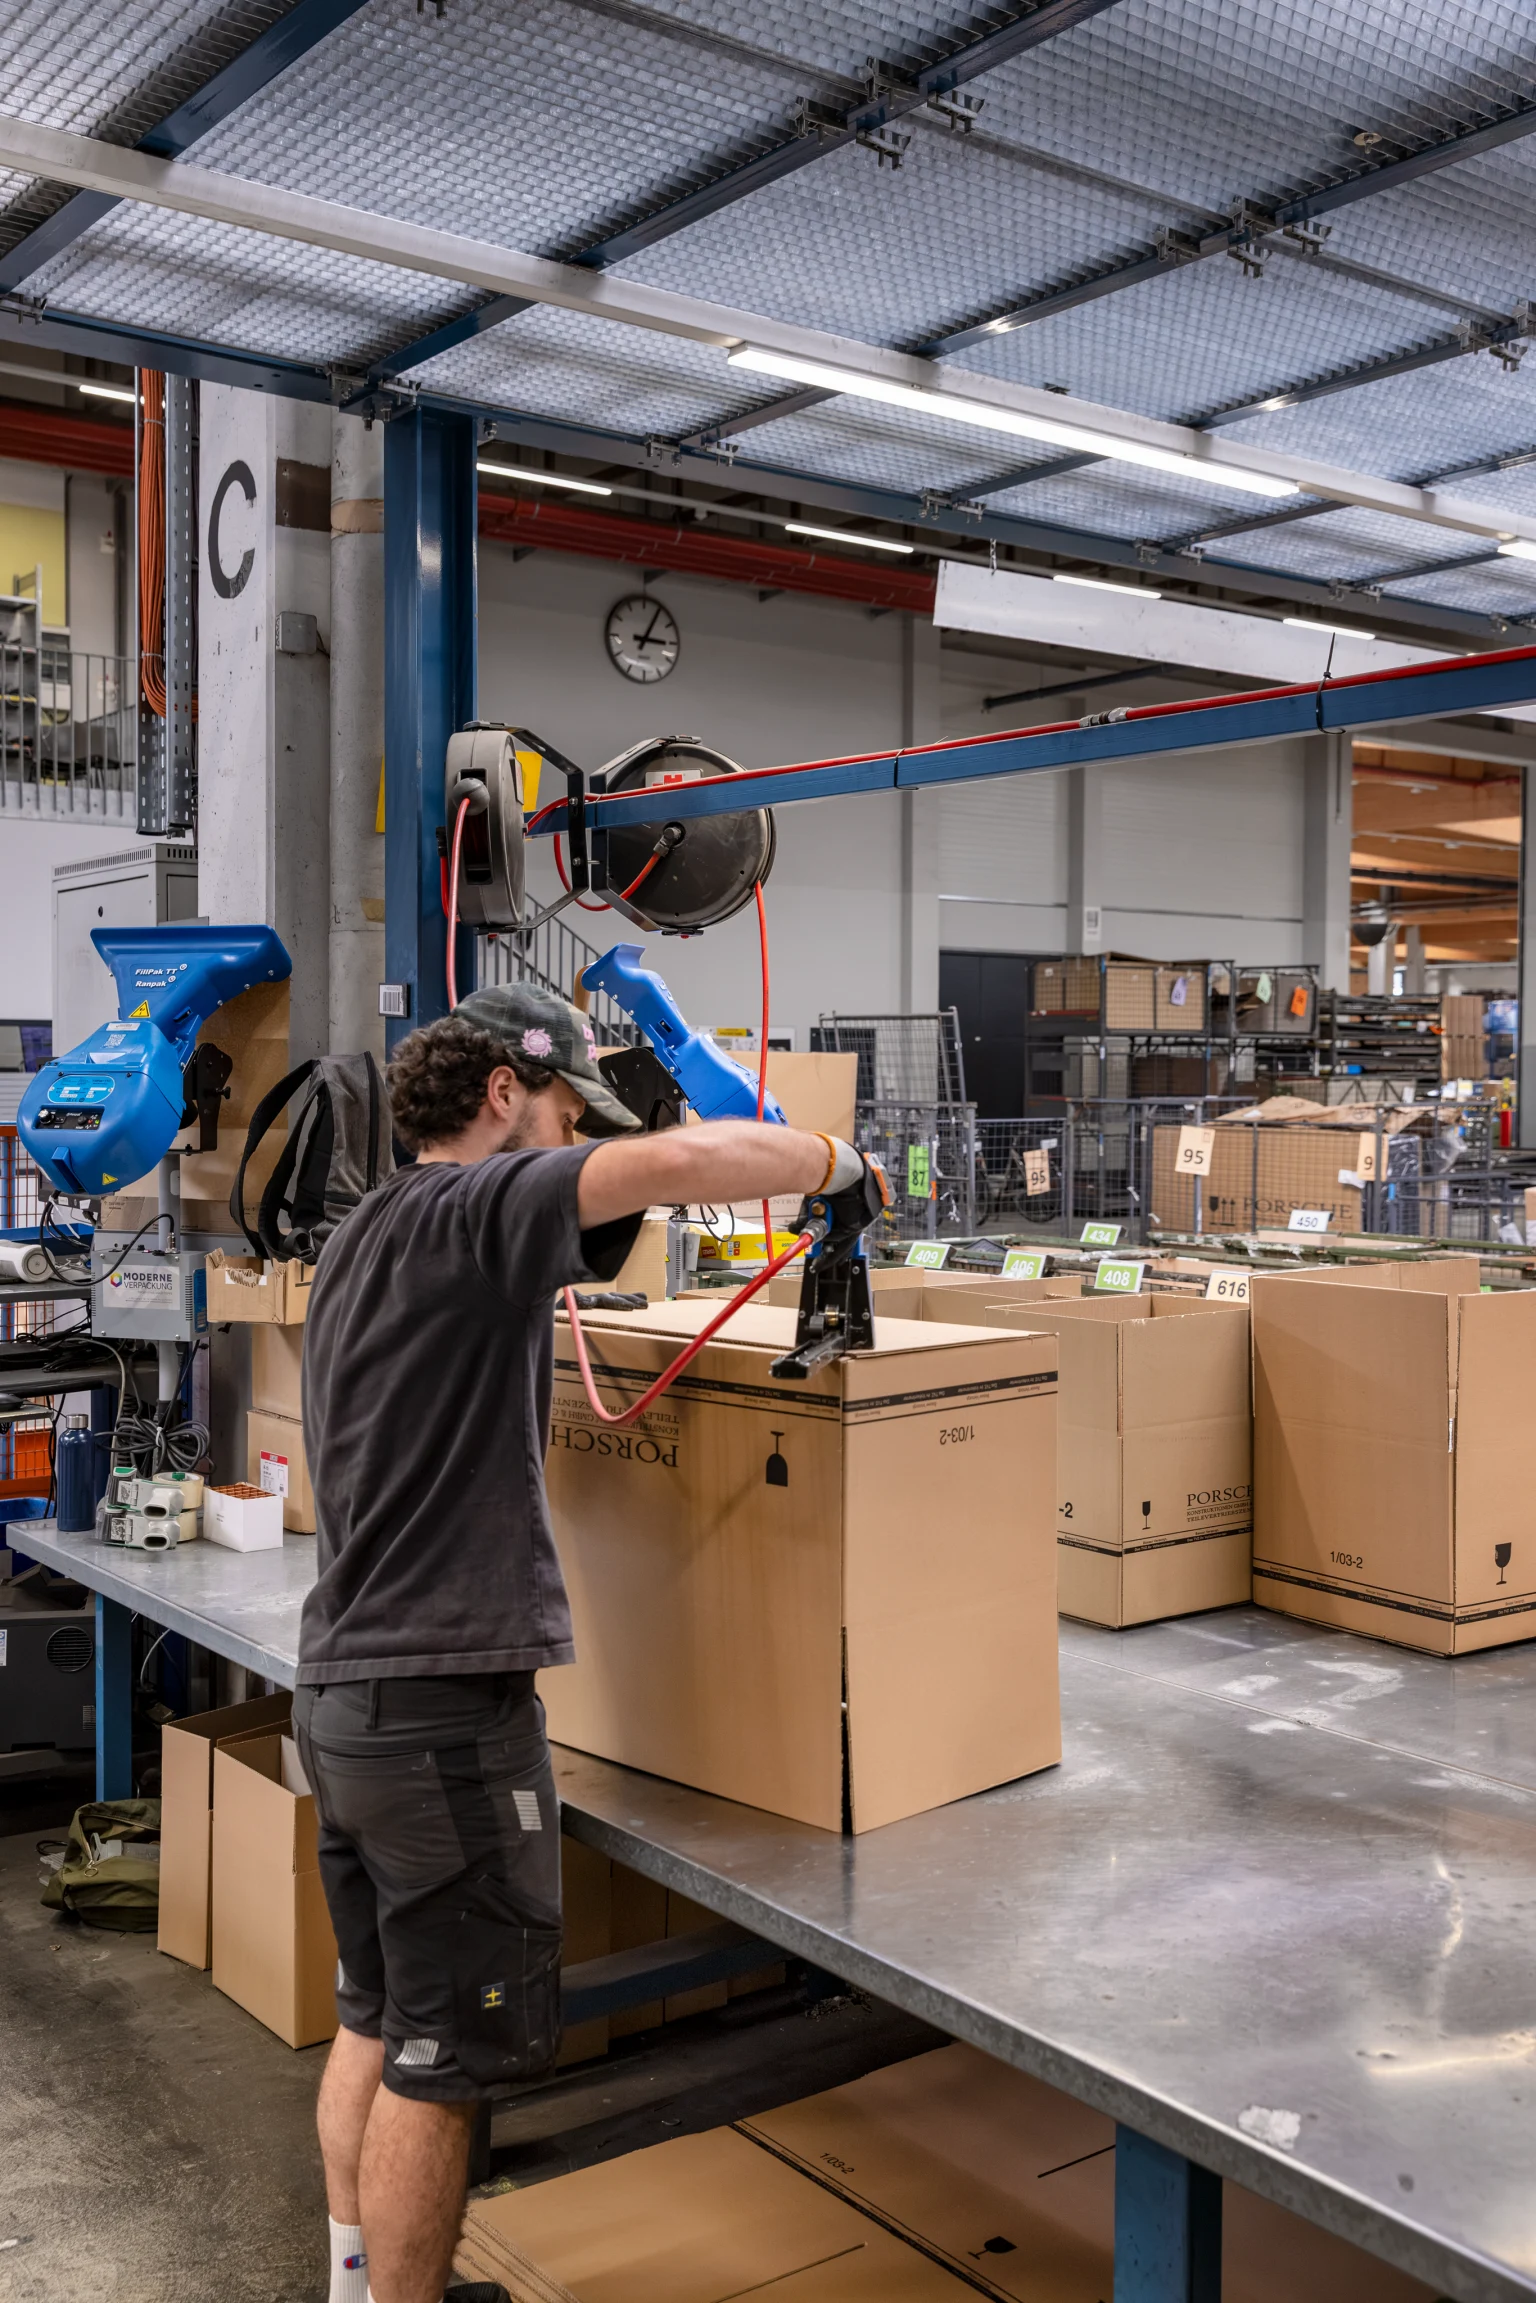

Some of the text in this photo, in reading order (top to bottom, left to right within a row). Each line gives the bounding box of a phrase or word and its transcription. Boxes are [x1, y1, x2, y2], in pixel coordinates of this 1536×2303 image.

[208, 459, 257, 599] C
[135, 980, 167, 988] Ranpak
[1183, 1148, 1204, 1165] 95
[911, 1169, 925, 1187] 87
[1031, 1169, 1047, 1186] 95
[1296, 1215, 1319, 1229] 450
[1088, 1230, 1112, 1244] 434
[914, 1249, 939, 1264] 409
[1010, 1259, 1035, 1276] 406
[123, 1272, 173, 1282] MODERNE
[1103, 1269, 1131, 1287] 408
[124, 1281, 173, 1291] VERPACKUNG
[1217, 1279, 1247, 1298] 616
[939, 1424, 975, 1446] 1/03-2
[1330, 1550, 1363, 1569] 1/03-2
[819, 2152, 855, 2174] 1/03-2
